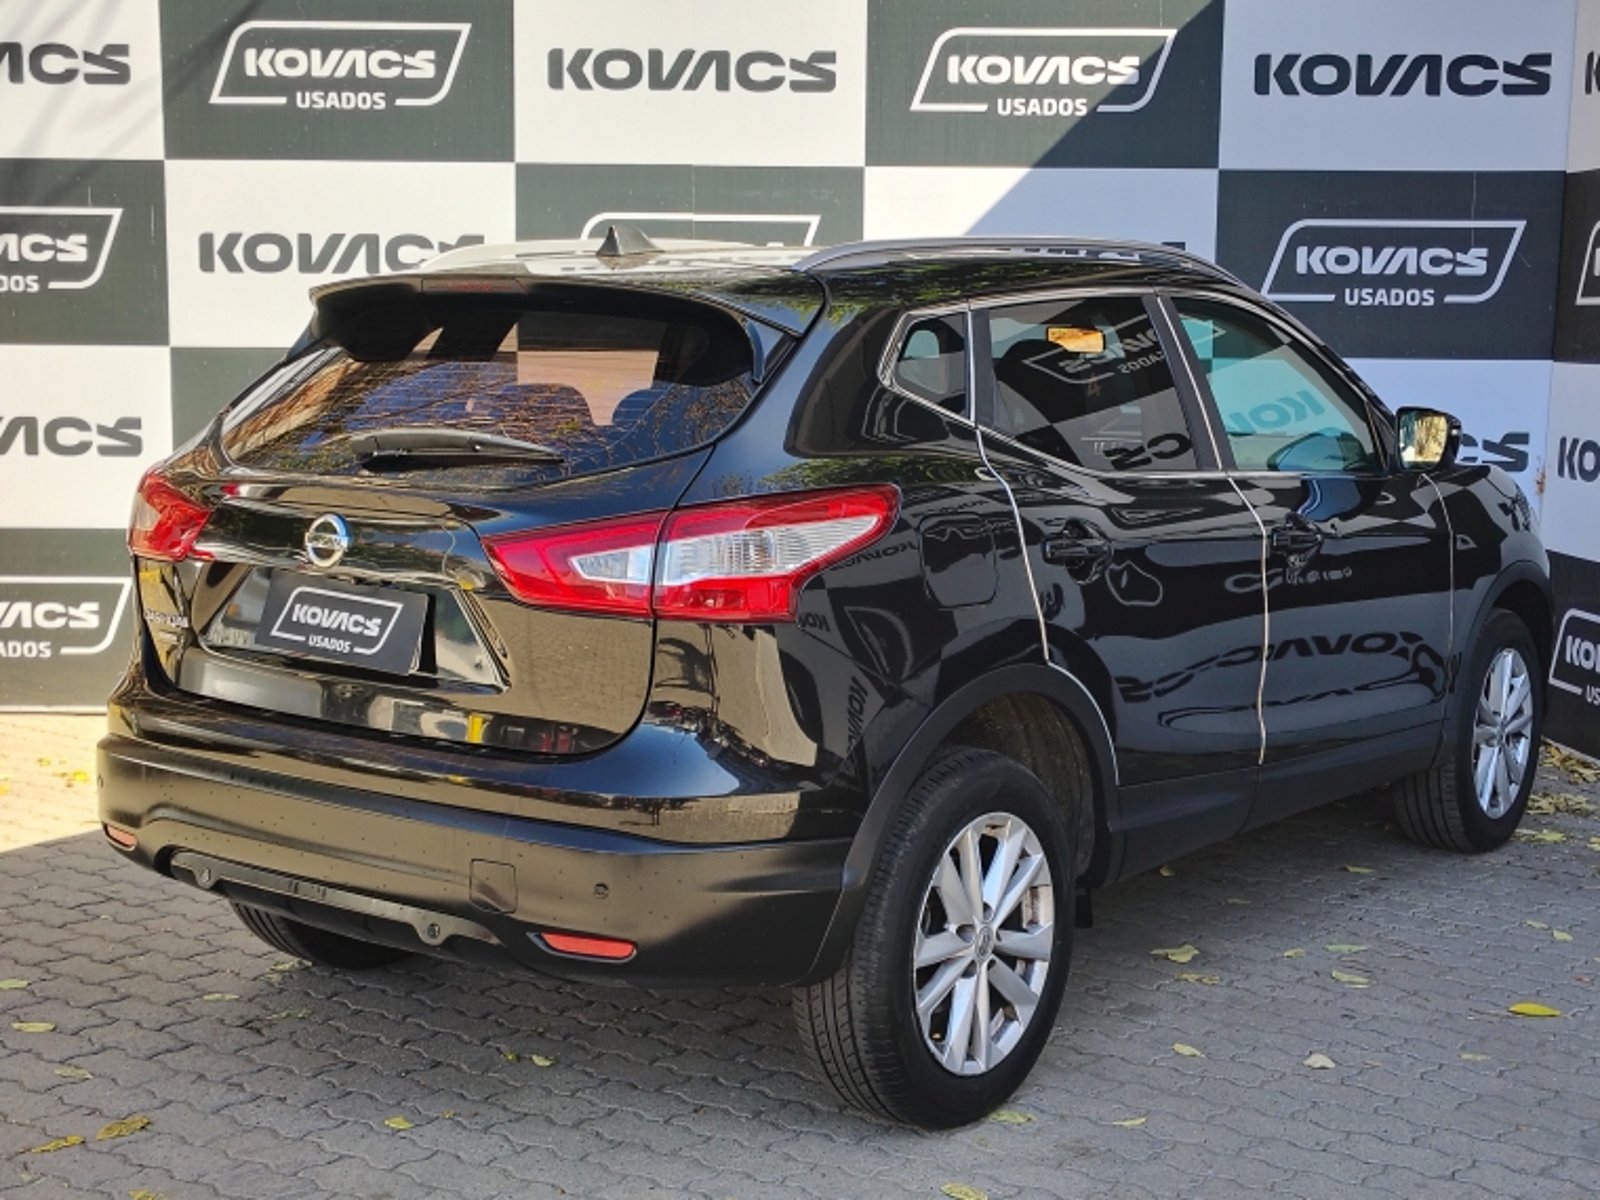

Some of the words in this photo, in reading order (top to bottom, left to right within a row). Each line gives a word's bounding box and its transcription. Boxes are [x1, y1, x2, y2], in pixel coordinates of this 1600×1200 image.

[244, 48, 436, 79] KOVACS
[547, 48, 837, 93] KOVACS
[947, 55, 1140, 85] KOVACS
[1253, 52, 1553, 97] KOVACS
[296, 91, 387, 110] USADOS
[997, 98, 1088, 116] USADOS
[1295, 246, 1488, 276] KOVACS
[1344, 288, 1435, 307] USADOS
[0, 416, 142, 457] ACS
[292, 603, 382, 637] KOVACS
[308, 634, 352, 654] USADOS
